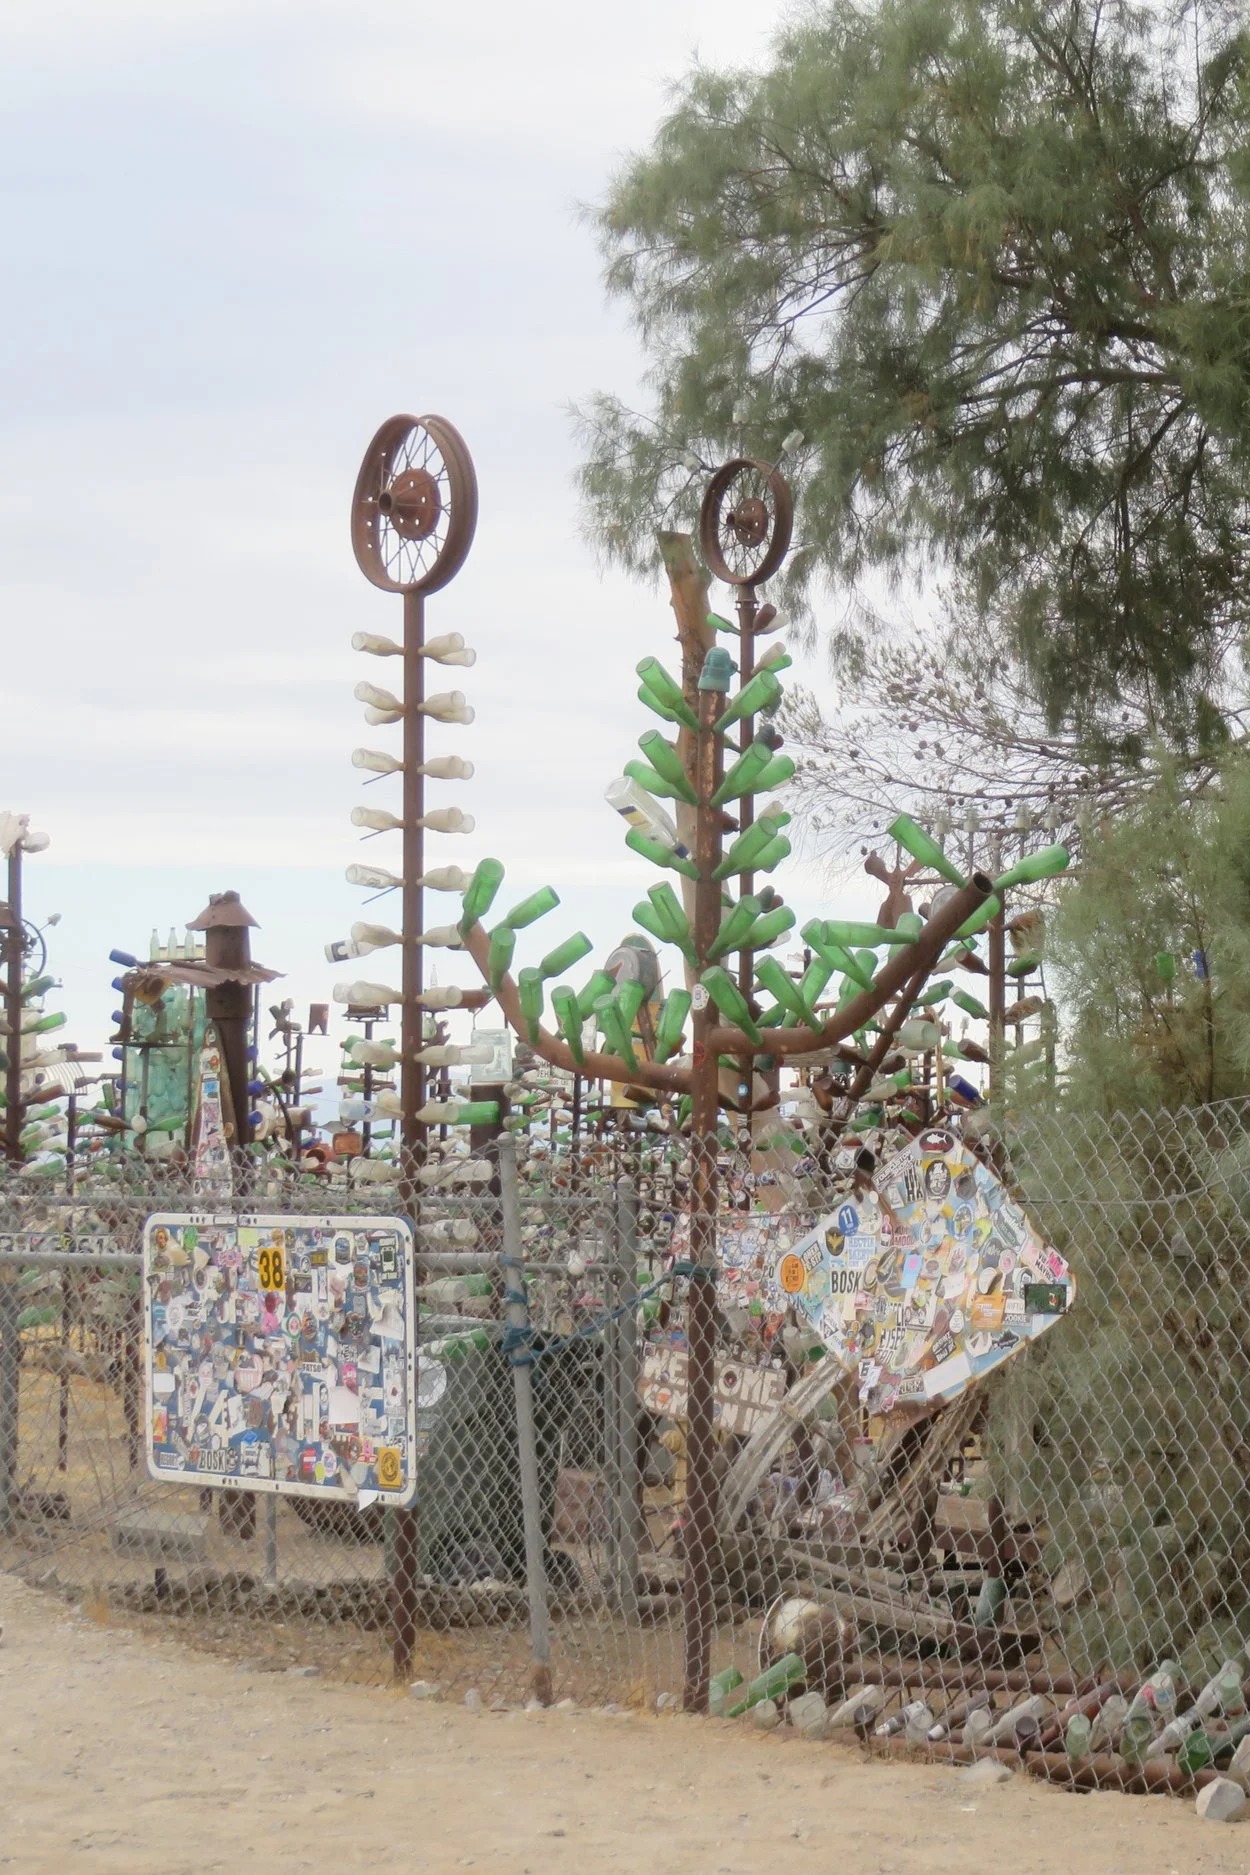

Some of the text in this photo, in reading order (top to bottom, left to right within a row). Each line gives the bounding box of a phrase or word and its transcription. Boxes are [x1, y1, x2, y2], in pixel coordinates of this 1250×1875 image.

[842, 1207, 854, 1229] 11
[259, 1250, 283, 1289] 38
[831, 1270, 863, 1294] BOSK
[200, 1450, 227, 1471] BOSK
